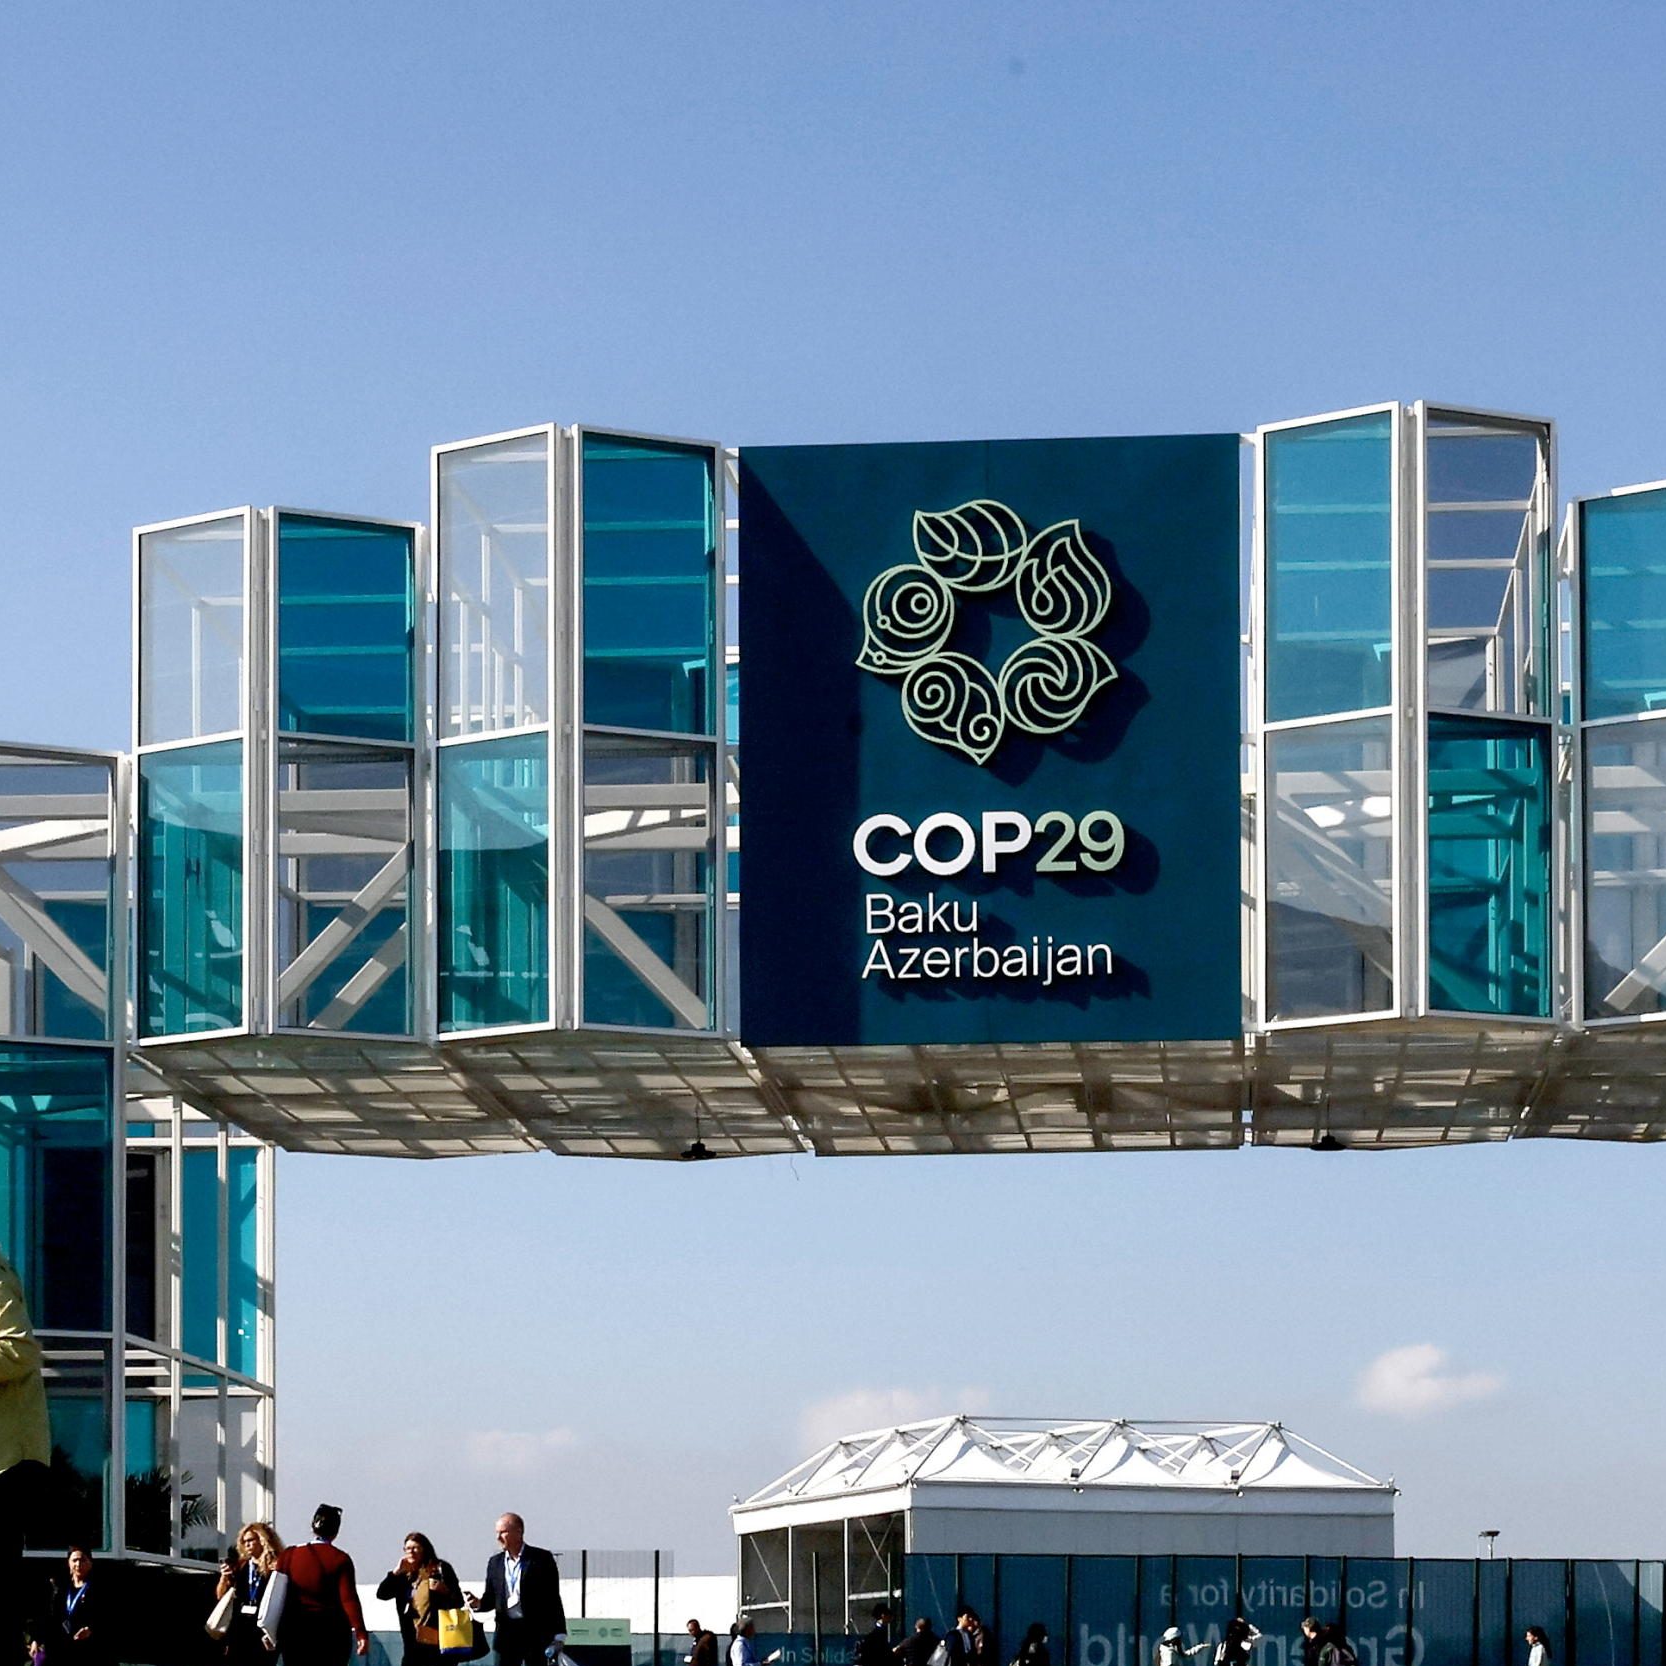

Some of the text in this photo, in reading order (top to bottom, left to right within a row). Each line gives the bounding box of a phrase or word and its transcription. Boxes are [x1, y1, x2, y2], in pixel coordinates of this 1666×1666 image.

[853, 810, 1125, 876] COP29
[865, 892, 978, 934] Baku
[862, 937, 1112, 985] Azerbaijan
